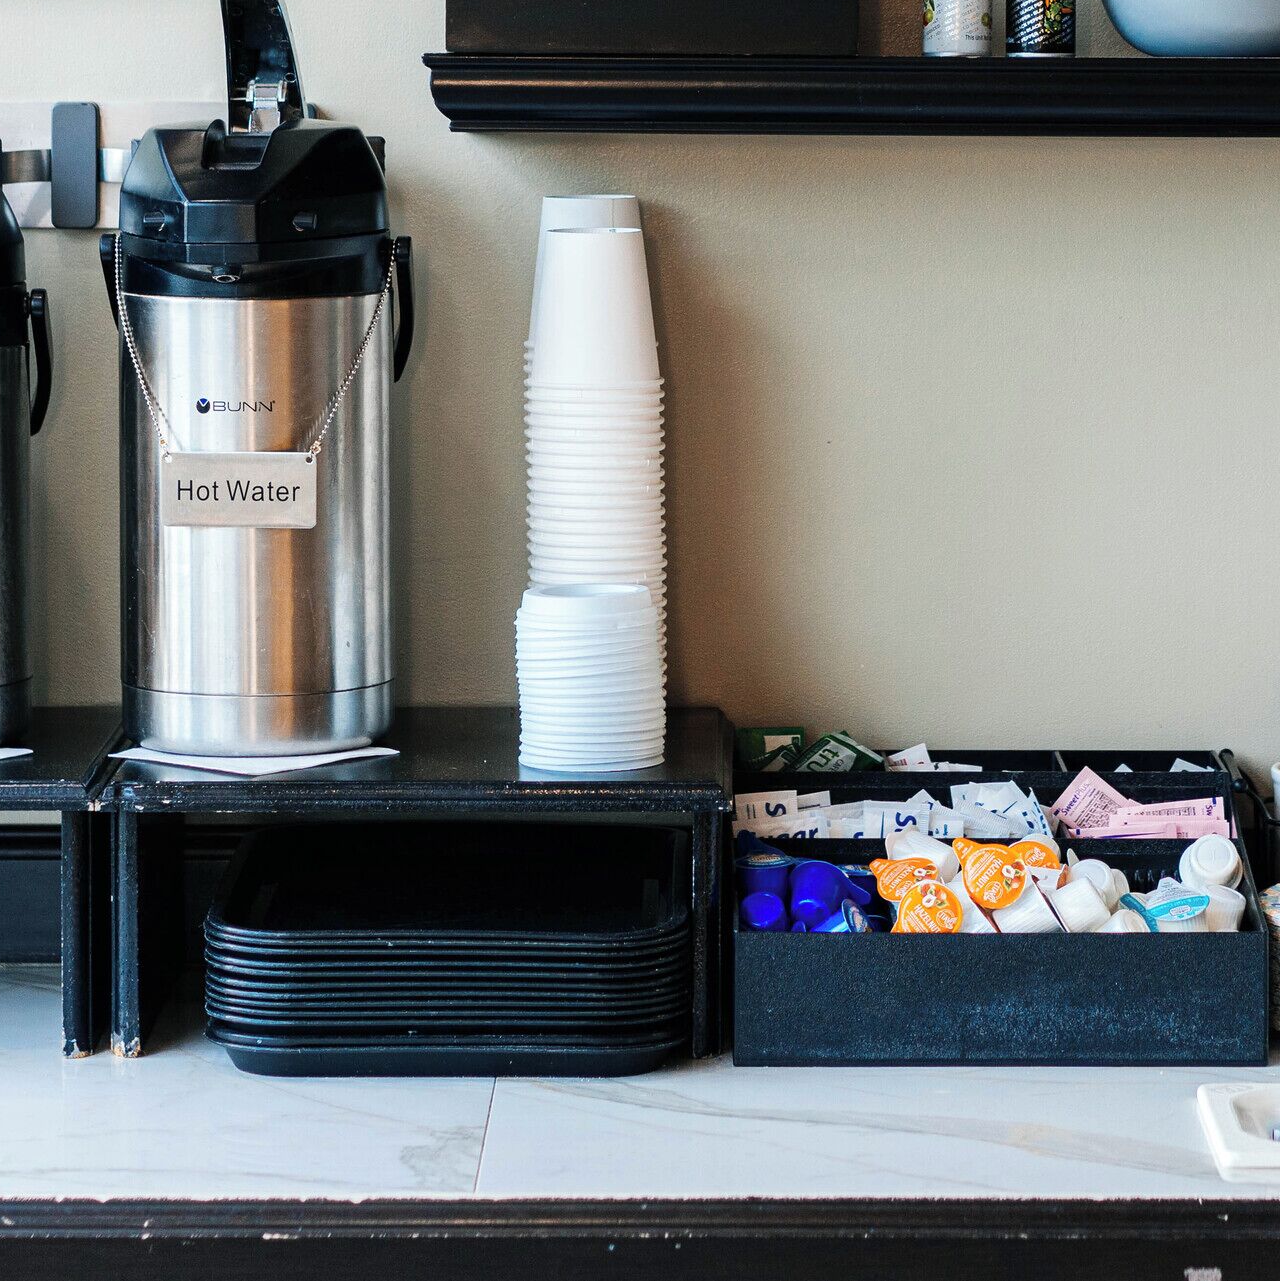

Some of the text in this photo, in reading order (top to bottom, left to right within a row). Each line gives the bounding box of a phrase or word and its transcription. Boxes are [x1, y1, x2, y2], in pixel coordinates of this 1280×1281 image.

[212, 401, 274, 412] BUNN
[177, 480, 301, 502] Hot Water
[976, 858, 1004, 889] HAZELNUT
[913, 904, 942, 933] HAZELNUT
